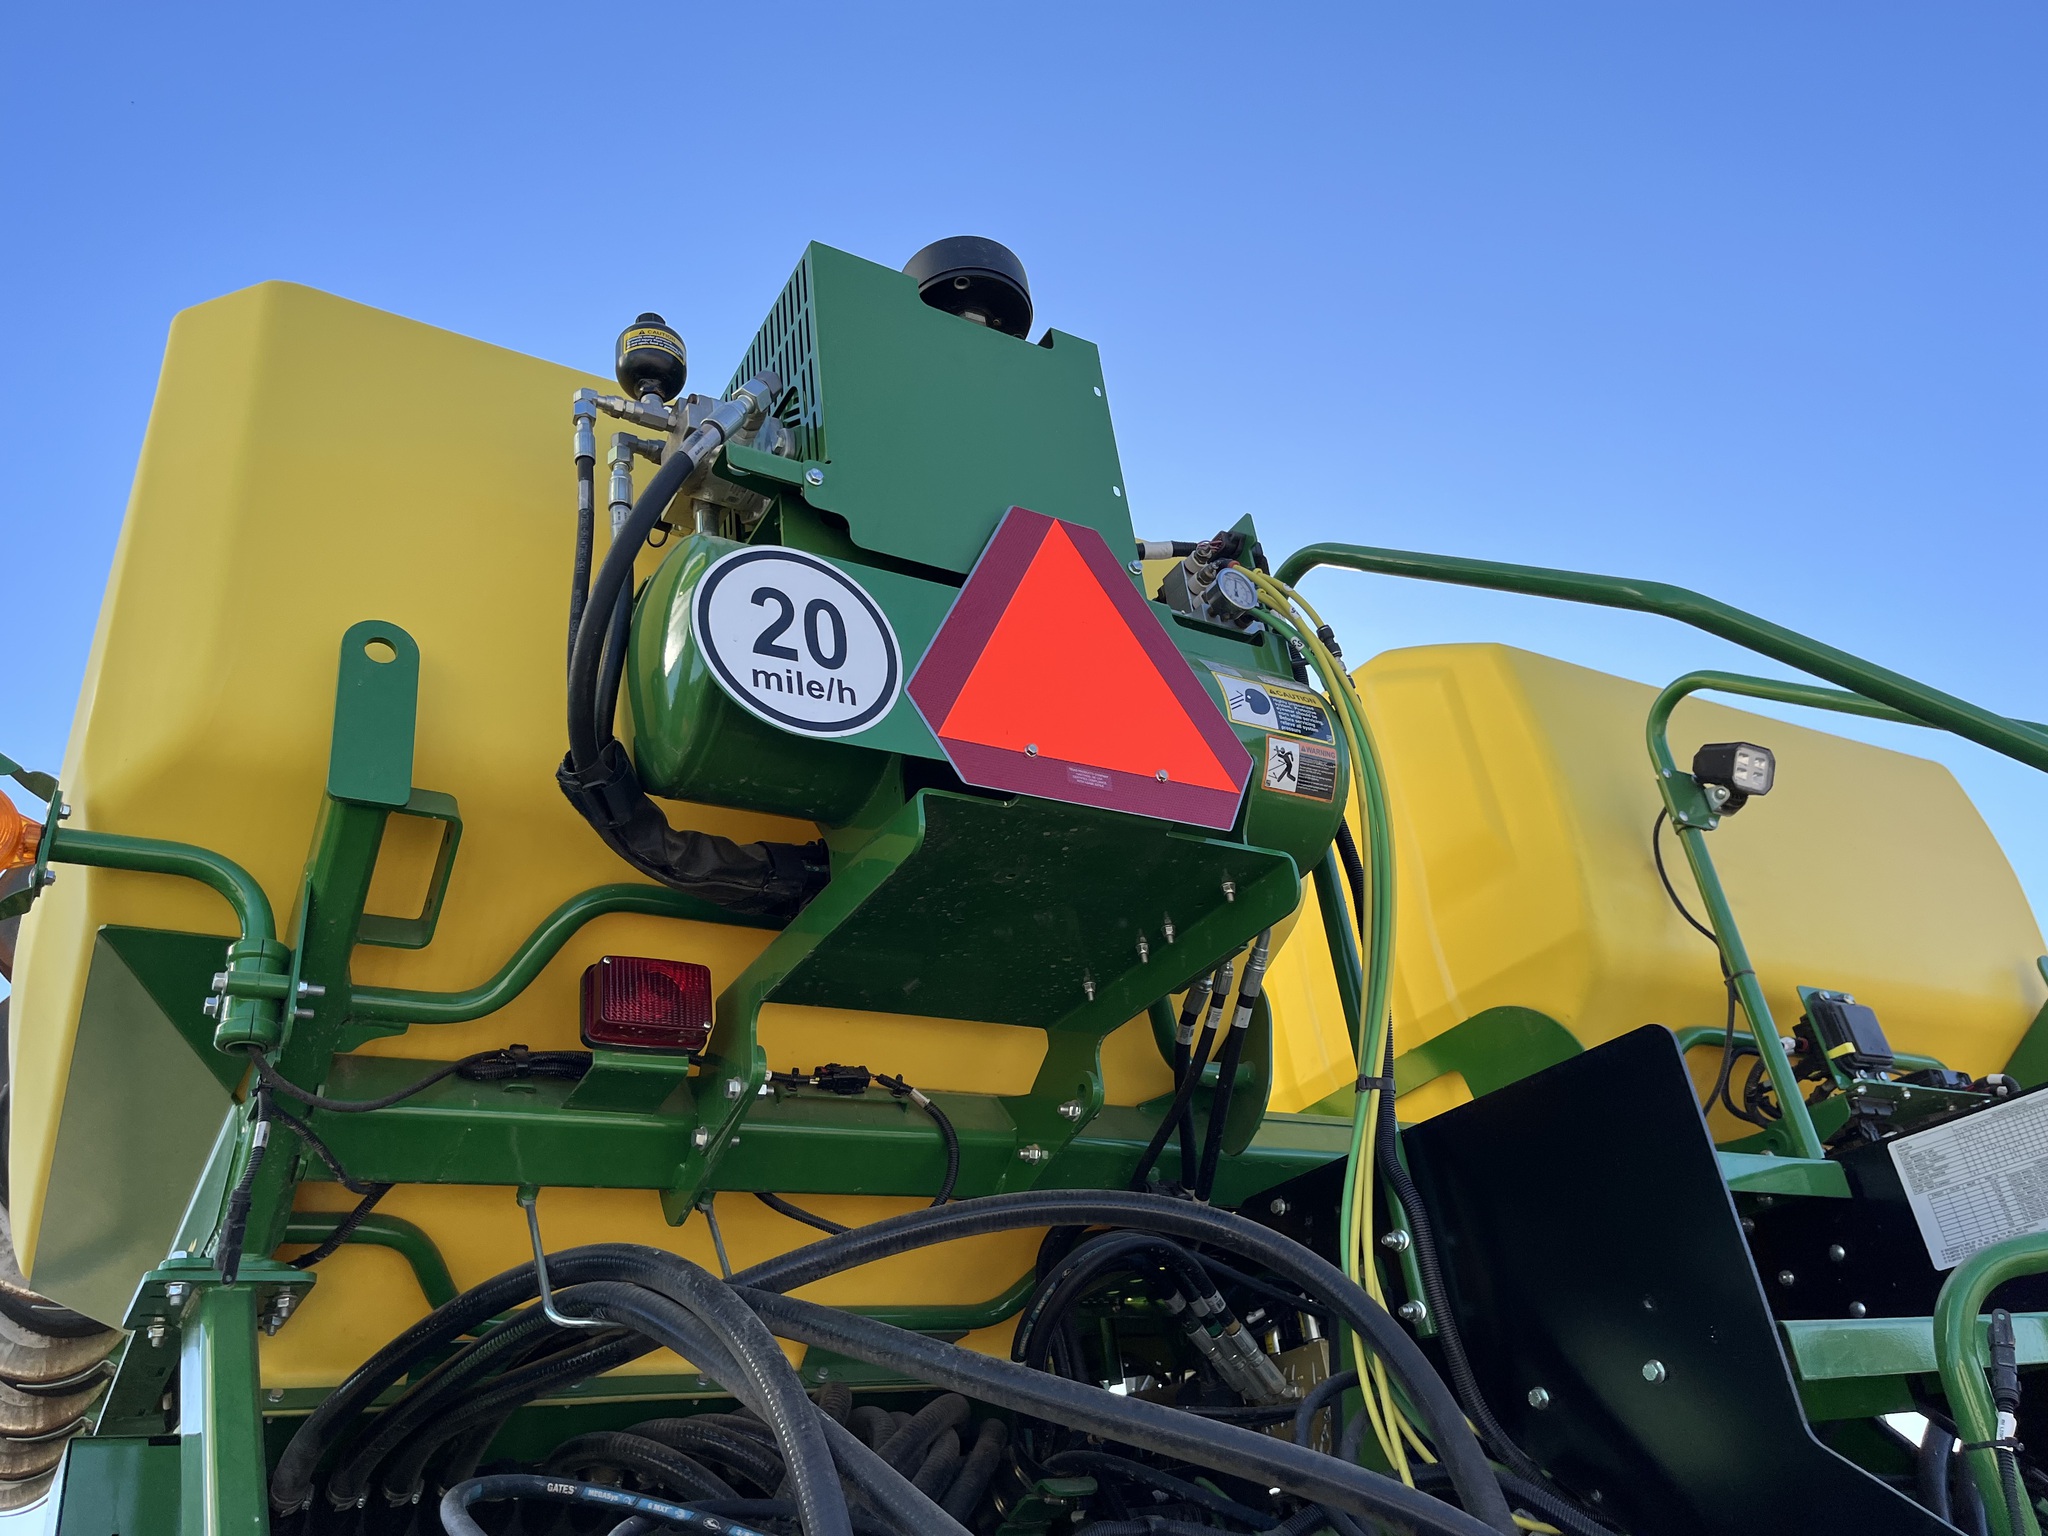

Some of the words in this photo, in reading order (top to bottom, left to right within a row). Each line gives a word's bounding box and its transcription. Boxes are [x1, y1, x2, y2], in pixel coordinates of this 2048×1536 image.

[647, 330, 676, 342] CAUTION
[751, 587, 847, 670] 20
[752, 668, 857, 706] mile/h
[1276, 690, 1317, 705] CAUTION
[1306, 746, 1336, 759] WARNING
[547, 1482, 575, 1495] GATES
